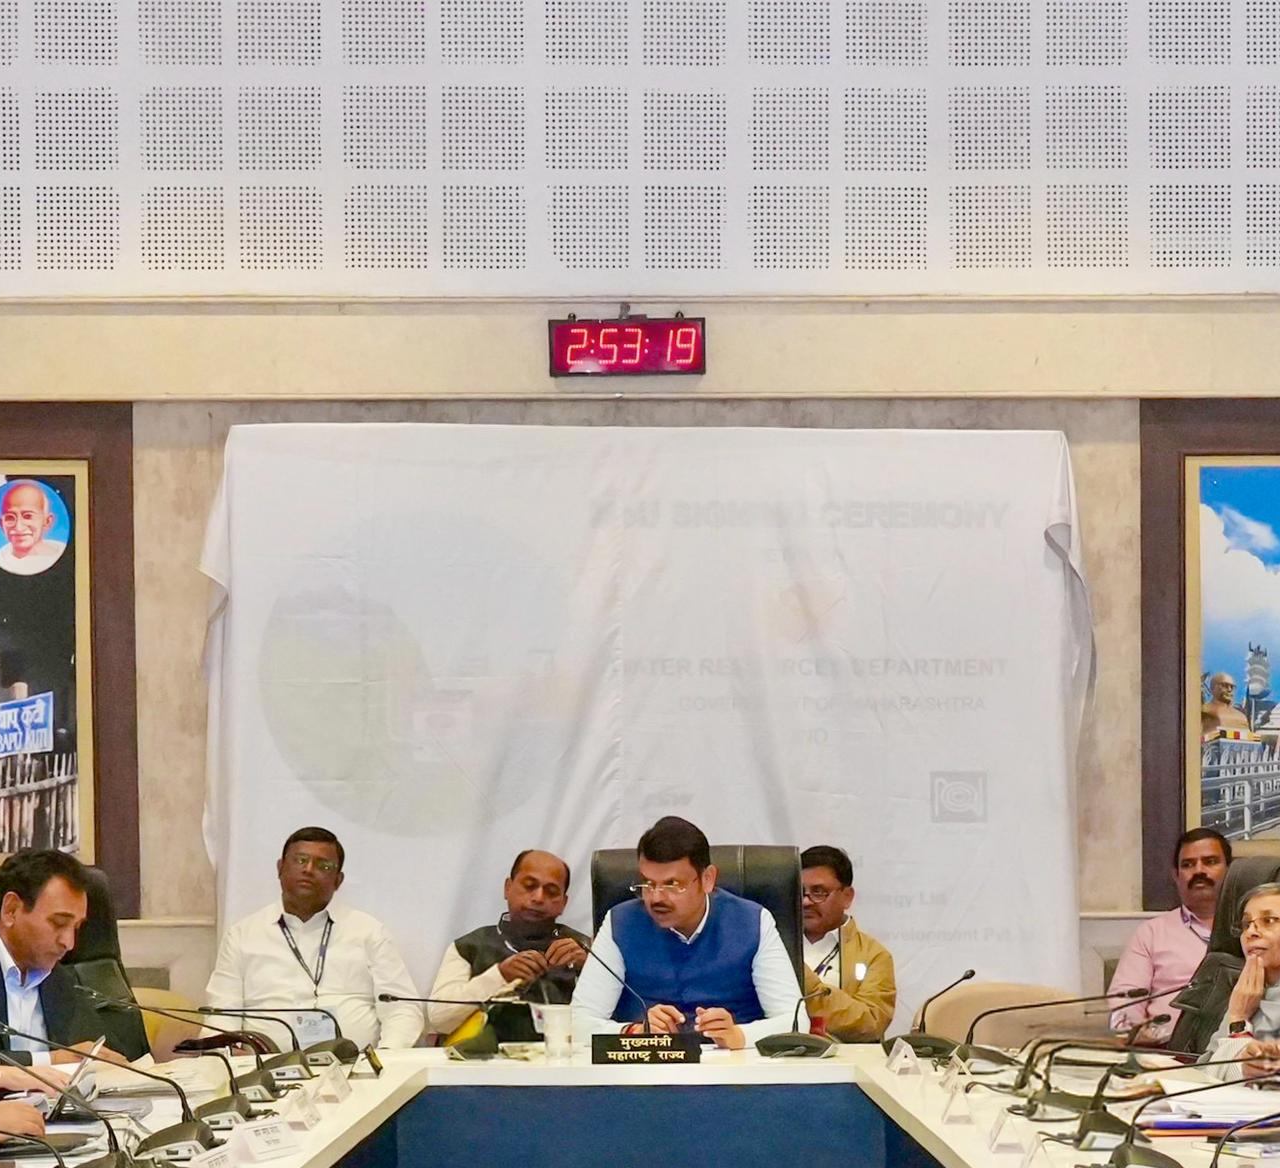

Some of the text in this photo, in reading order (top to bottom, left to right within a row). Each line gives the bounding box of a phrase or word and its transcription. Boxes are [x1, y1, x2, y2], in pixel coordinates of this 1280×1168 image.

[566, 327, 697, 365] 2:53:19
[821, 500, 1008, 529] CEREMONY
[853, 658, 1009, 677] DEPARTMENT
[619, 1035, 673, 1050] मुख्यमंत्री
[606, 1050, 686, 1062] महाराष्ट्र राज्य
